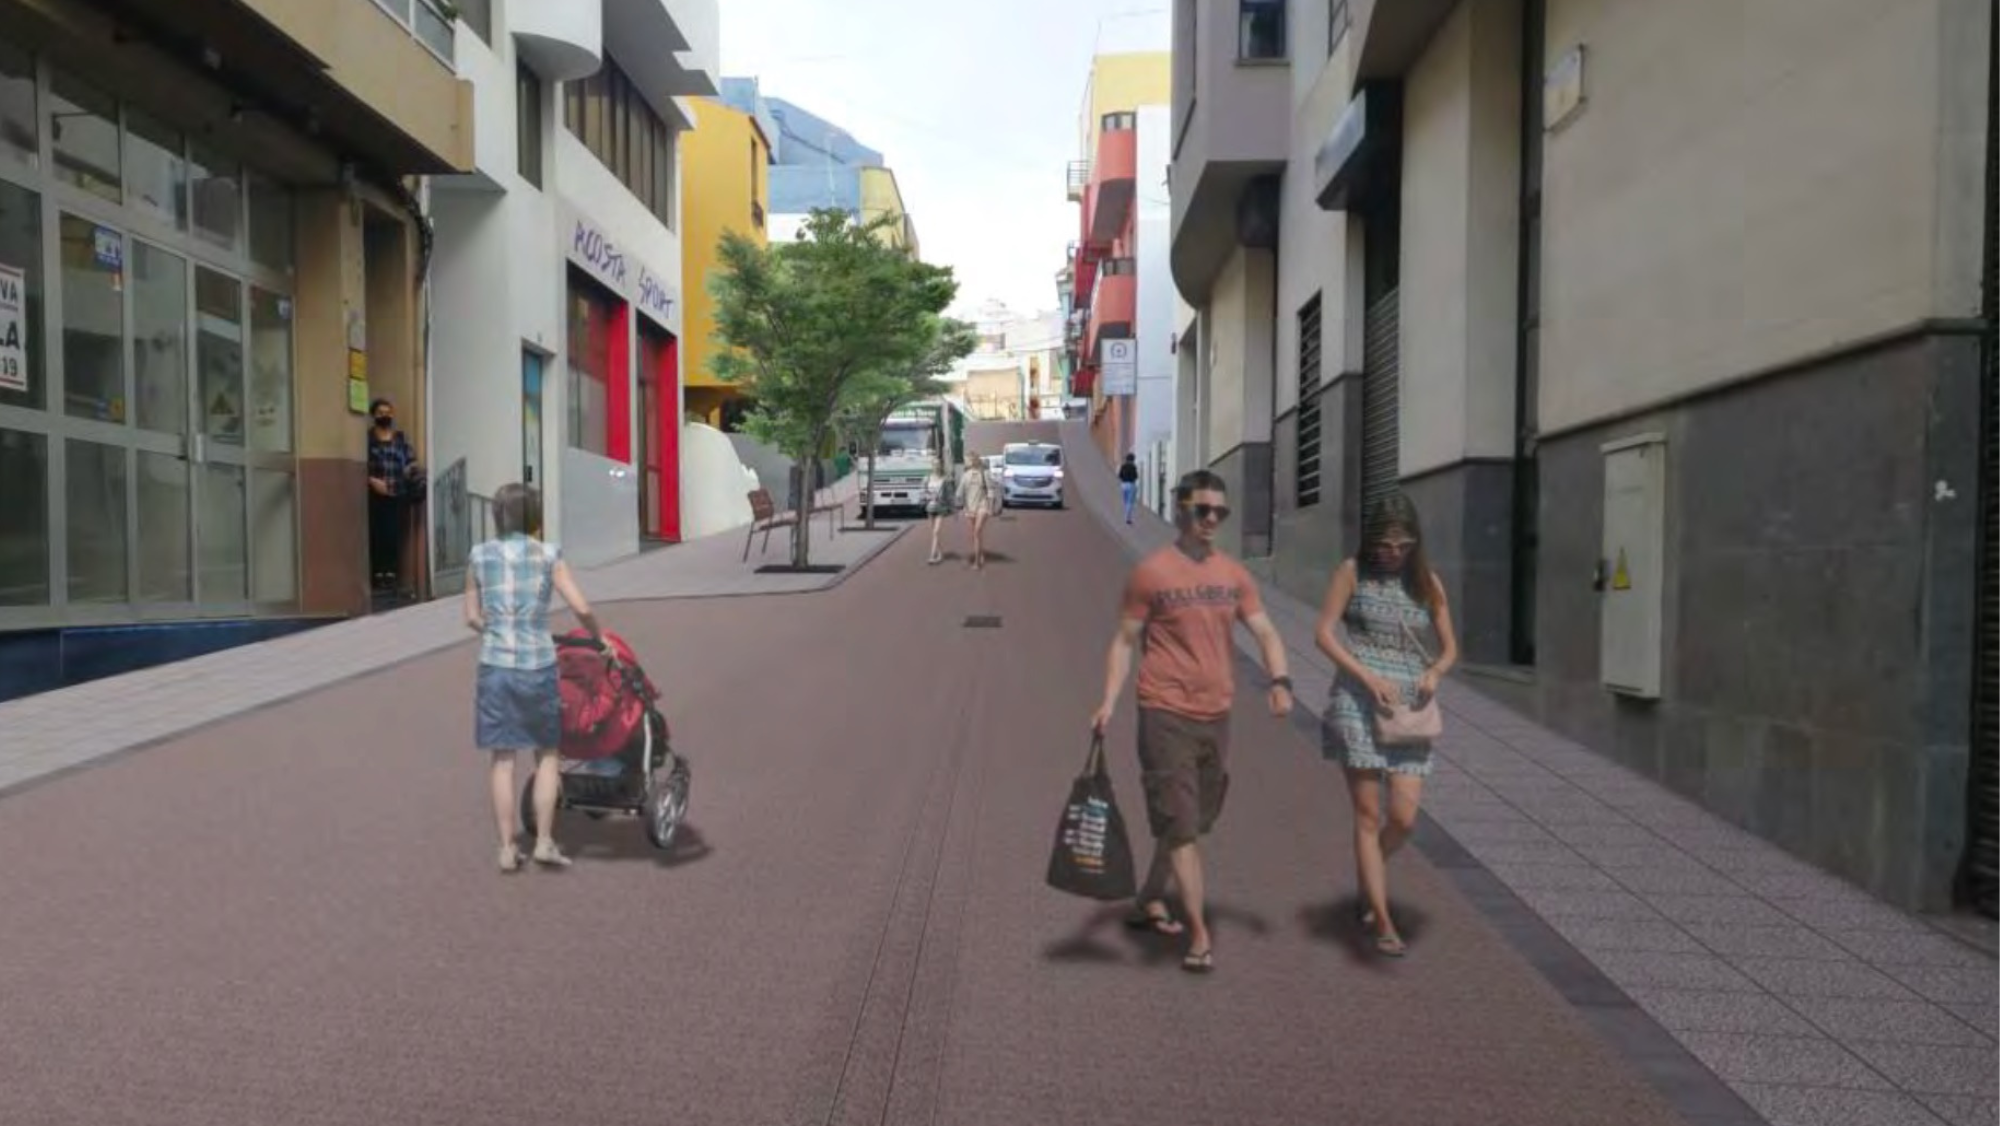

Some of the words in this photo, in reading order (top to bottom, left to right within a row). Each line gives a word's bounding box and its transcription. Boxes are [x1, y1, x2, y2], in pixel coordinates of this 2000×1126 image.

[574, 219, 626, 288] ACOSTA
[638, 265, 675, 319] SPORT
[0, 321, 20, 350] A
